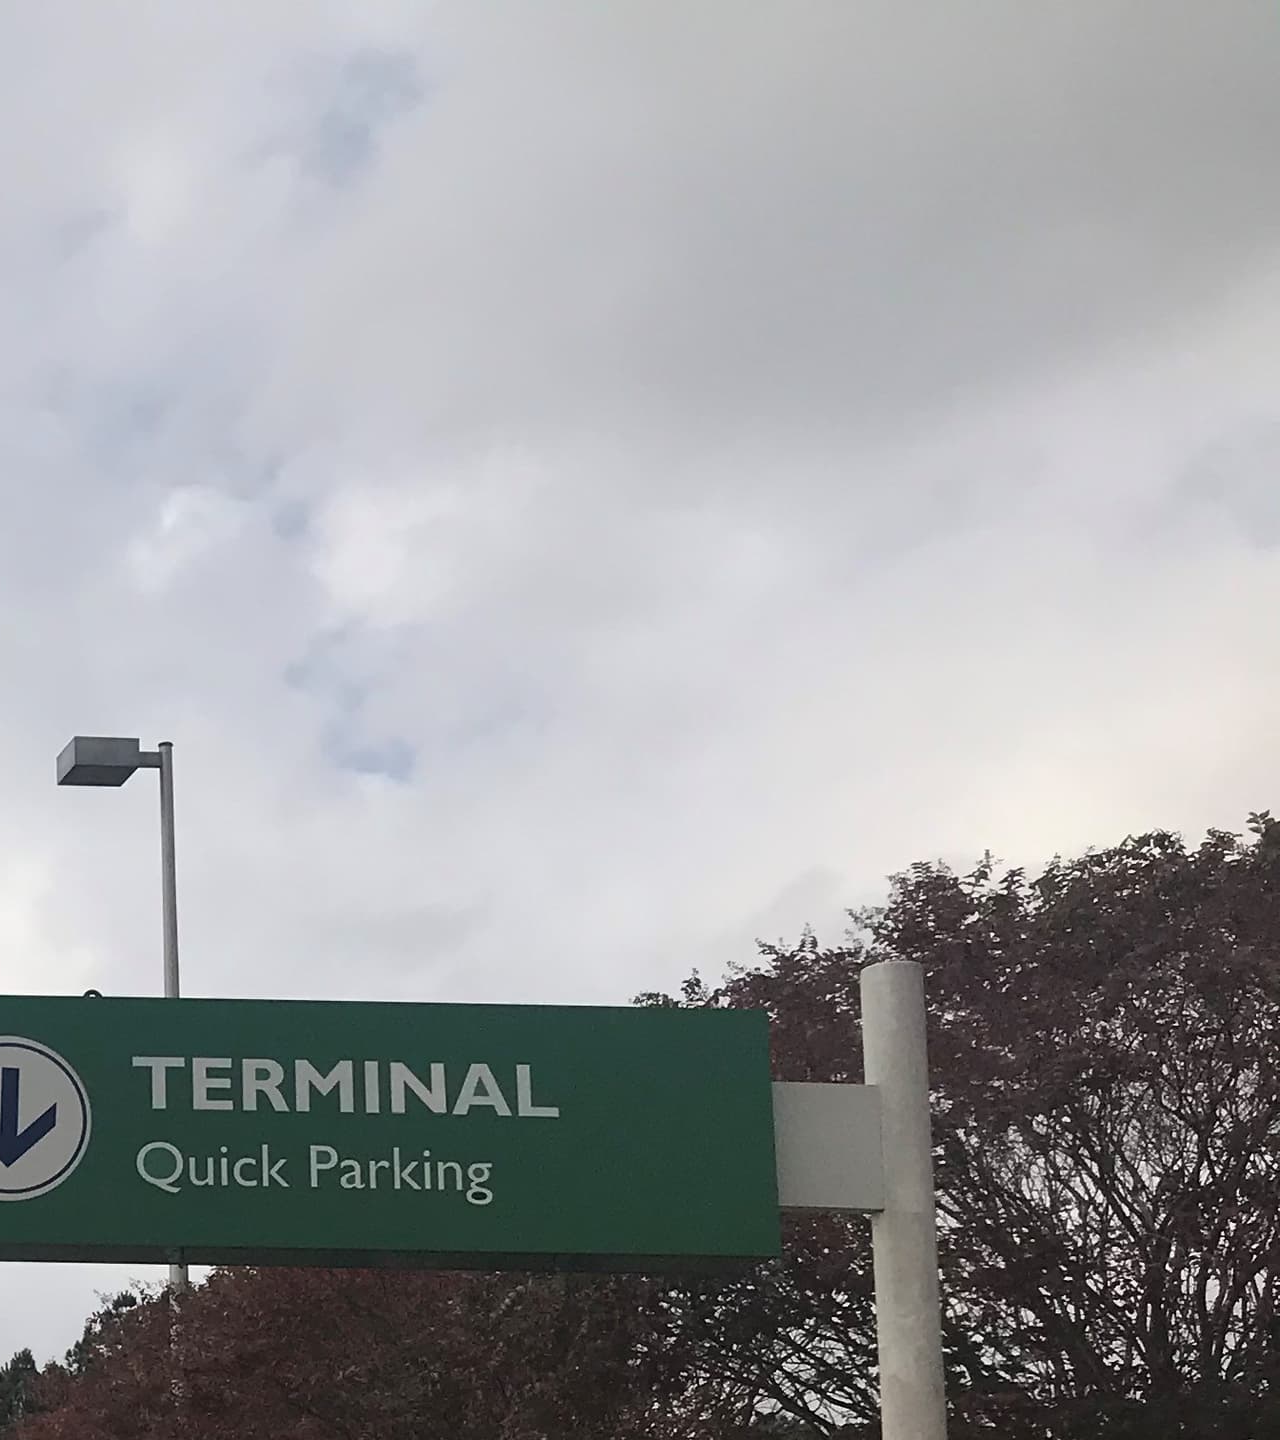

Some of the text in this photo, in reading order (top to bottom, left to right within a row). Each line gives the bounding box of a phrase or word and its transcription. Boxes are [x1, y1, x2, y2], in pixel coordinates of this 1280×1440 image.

[132, 1056, 560, 1118] TERMINAL
[136, 1141, 495, 1207] Quick Parking
